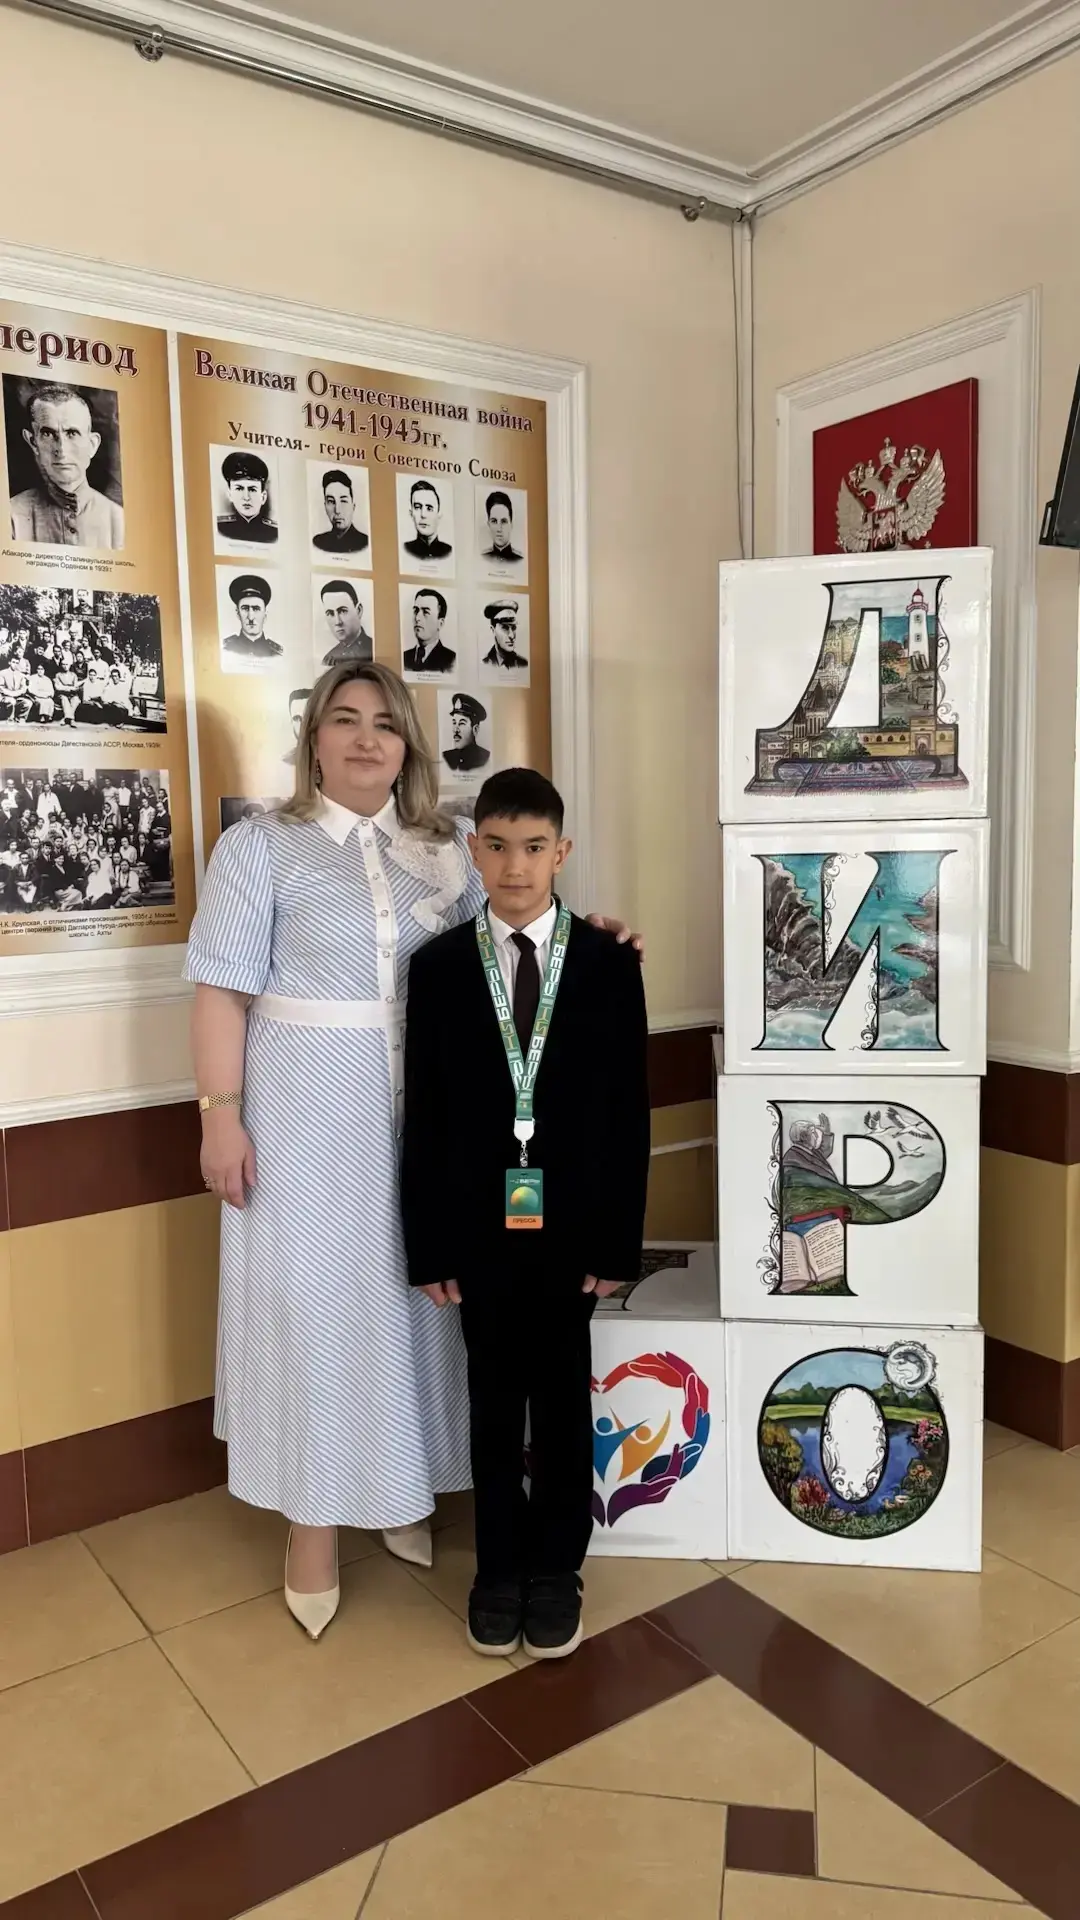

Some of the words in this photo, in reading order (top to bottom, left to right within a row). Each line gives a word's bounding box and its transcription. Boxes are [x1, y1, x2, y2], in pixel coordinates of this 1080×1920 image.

[194, 348, 297, 392] Великая
[307, 369, 469, 423] Отечественная
[477, 407, 534, 433] война
[302, 401, 448, 449] 1941-1945гг.
[319, 441, 366, 461] герои
[374, 444, 462, 475] Советского
[468, 458, 517, 483] Союза
[60, 561, 88, 570] Орденом
[12, 920, 42, 928] Крупская,
